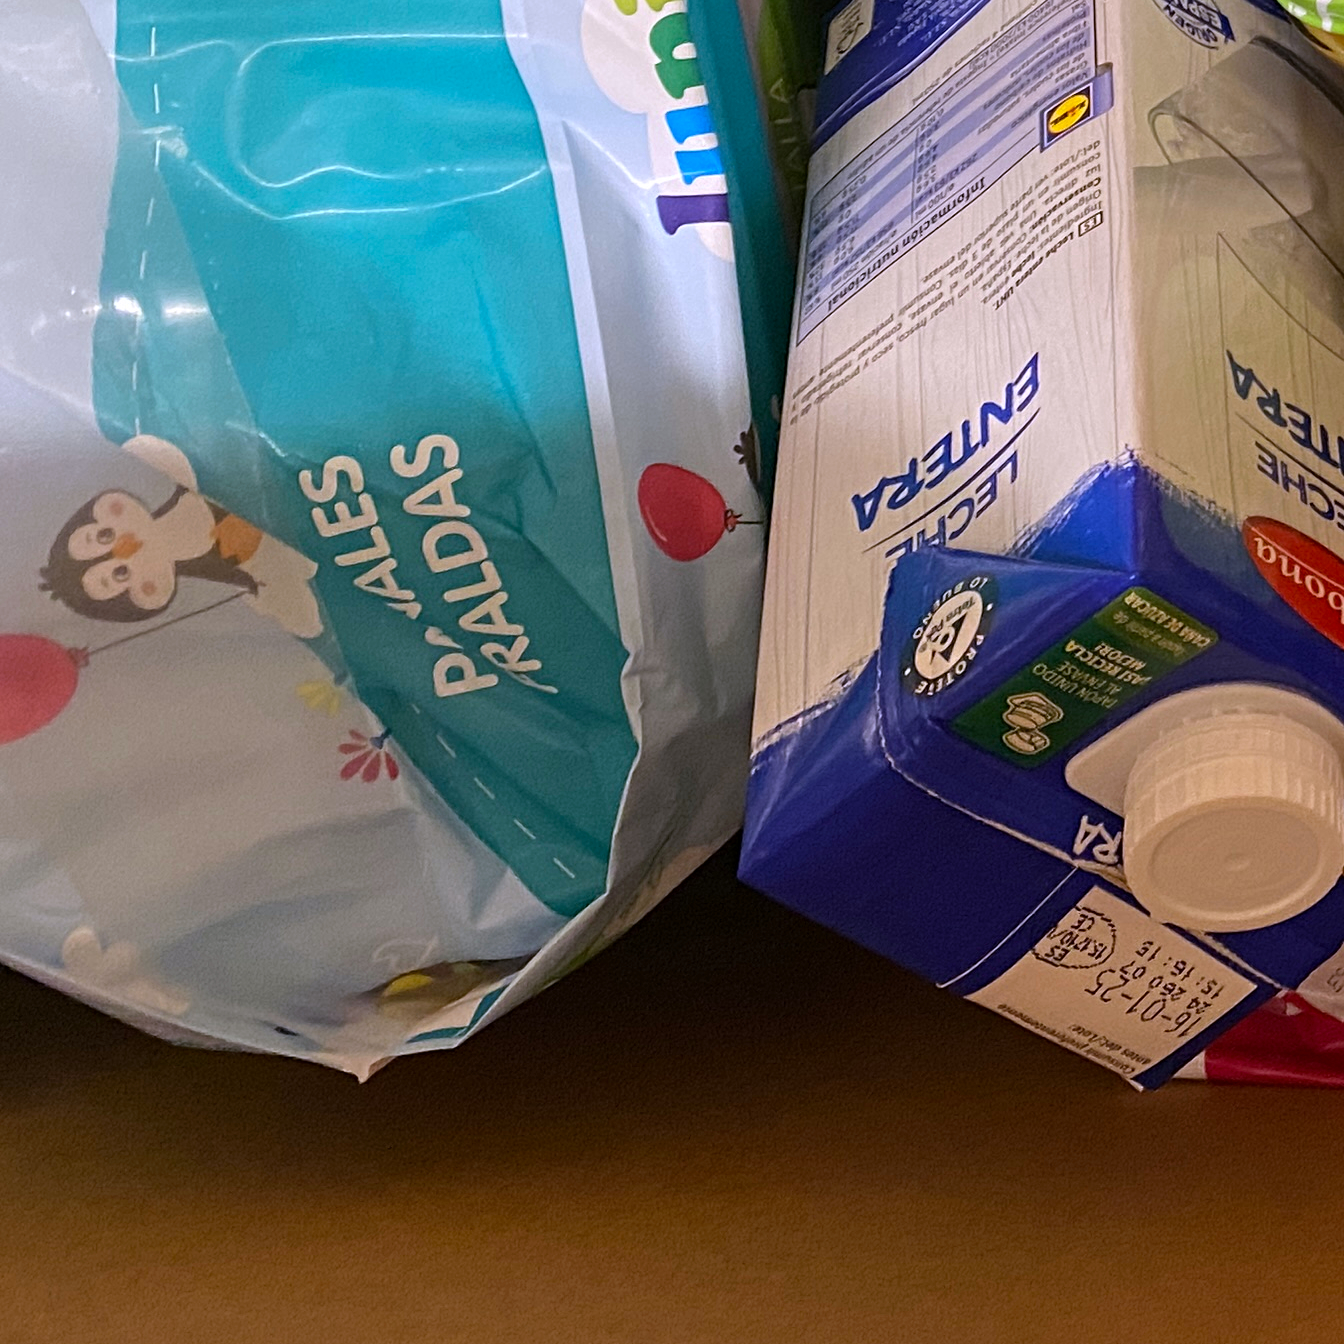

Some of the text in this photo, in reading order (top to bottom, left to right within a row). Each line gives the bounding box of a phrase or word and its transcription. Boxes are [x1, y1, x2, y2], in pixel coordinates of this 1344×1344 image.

[827, 176, 986, 312] Información nutricional
[850, 350, 1041, 534] ENTERA
[1064, 639, 1122, 678] RECICLA
[1070, 914, 1096, 932] CE
[1045, 945, 1070, 962] ES
[1084, 968, 1201, 1038] 16-01-25
[997, 1003, 1087, 1053] preferentemente
[1120, 1048, 1151, 1067] antes
